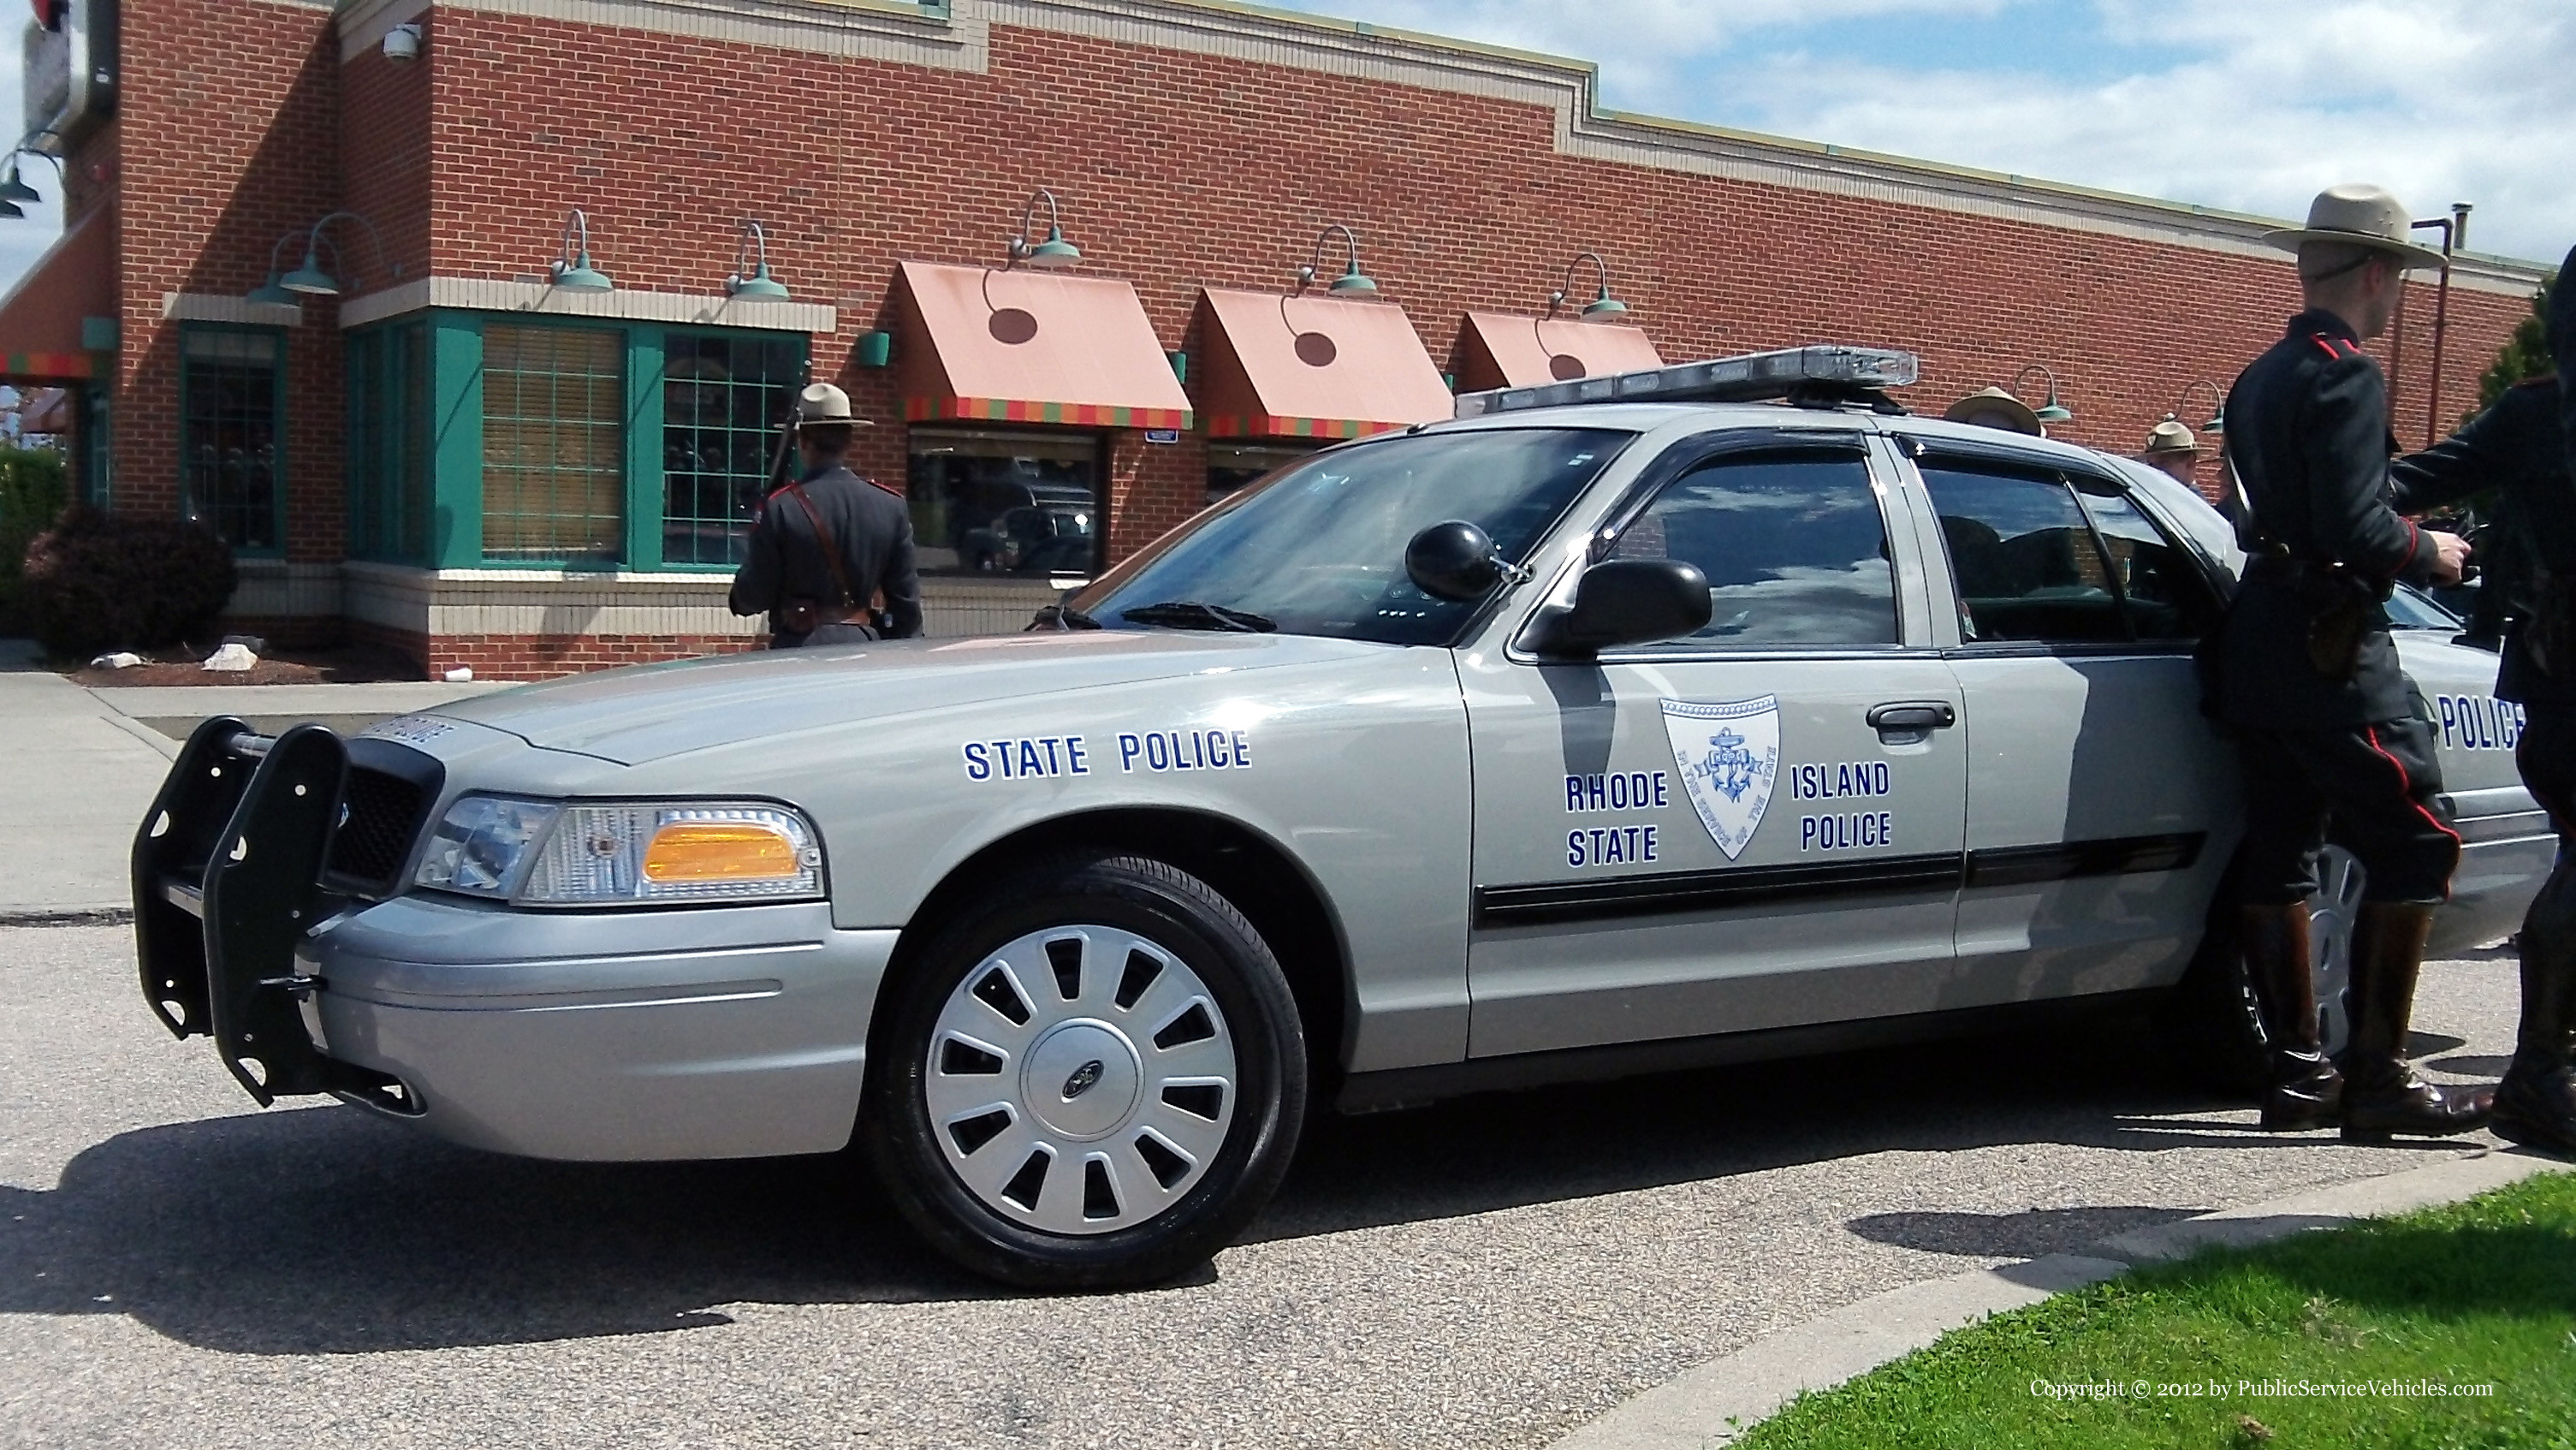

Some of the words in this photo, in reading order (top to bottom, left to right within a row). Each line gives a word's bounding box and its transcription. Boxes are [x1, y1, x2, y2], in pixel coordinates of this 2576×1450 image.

[963, 736, 1090, 781] STATE
[1117, 729, 1252, 774] POLICE
[1564, 770, 1668, 812] RHODE
[1790, 761, 1890, 799] ISLAND
[1567, 824, 1659, 867] STATE
[1801, 811, 1891, 852] POLICE
